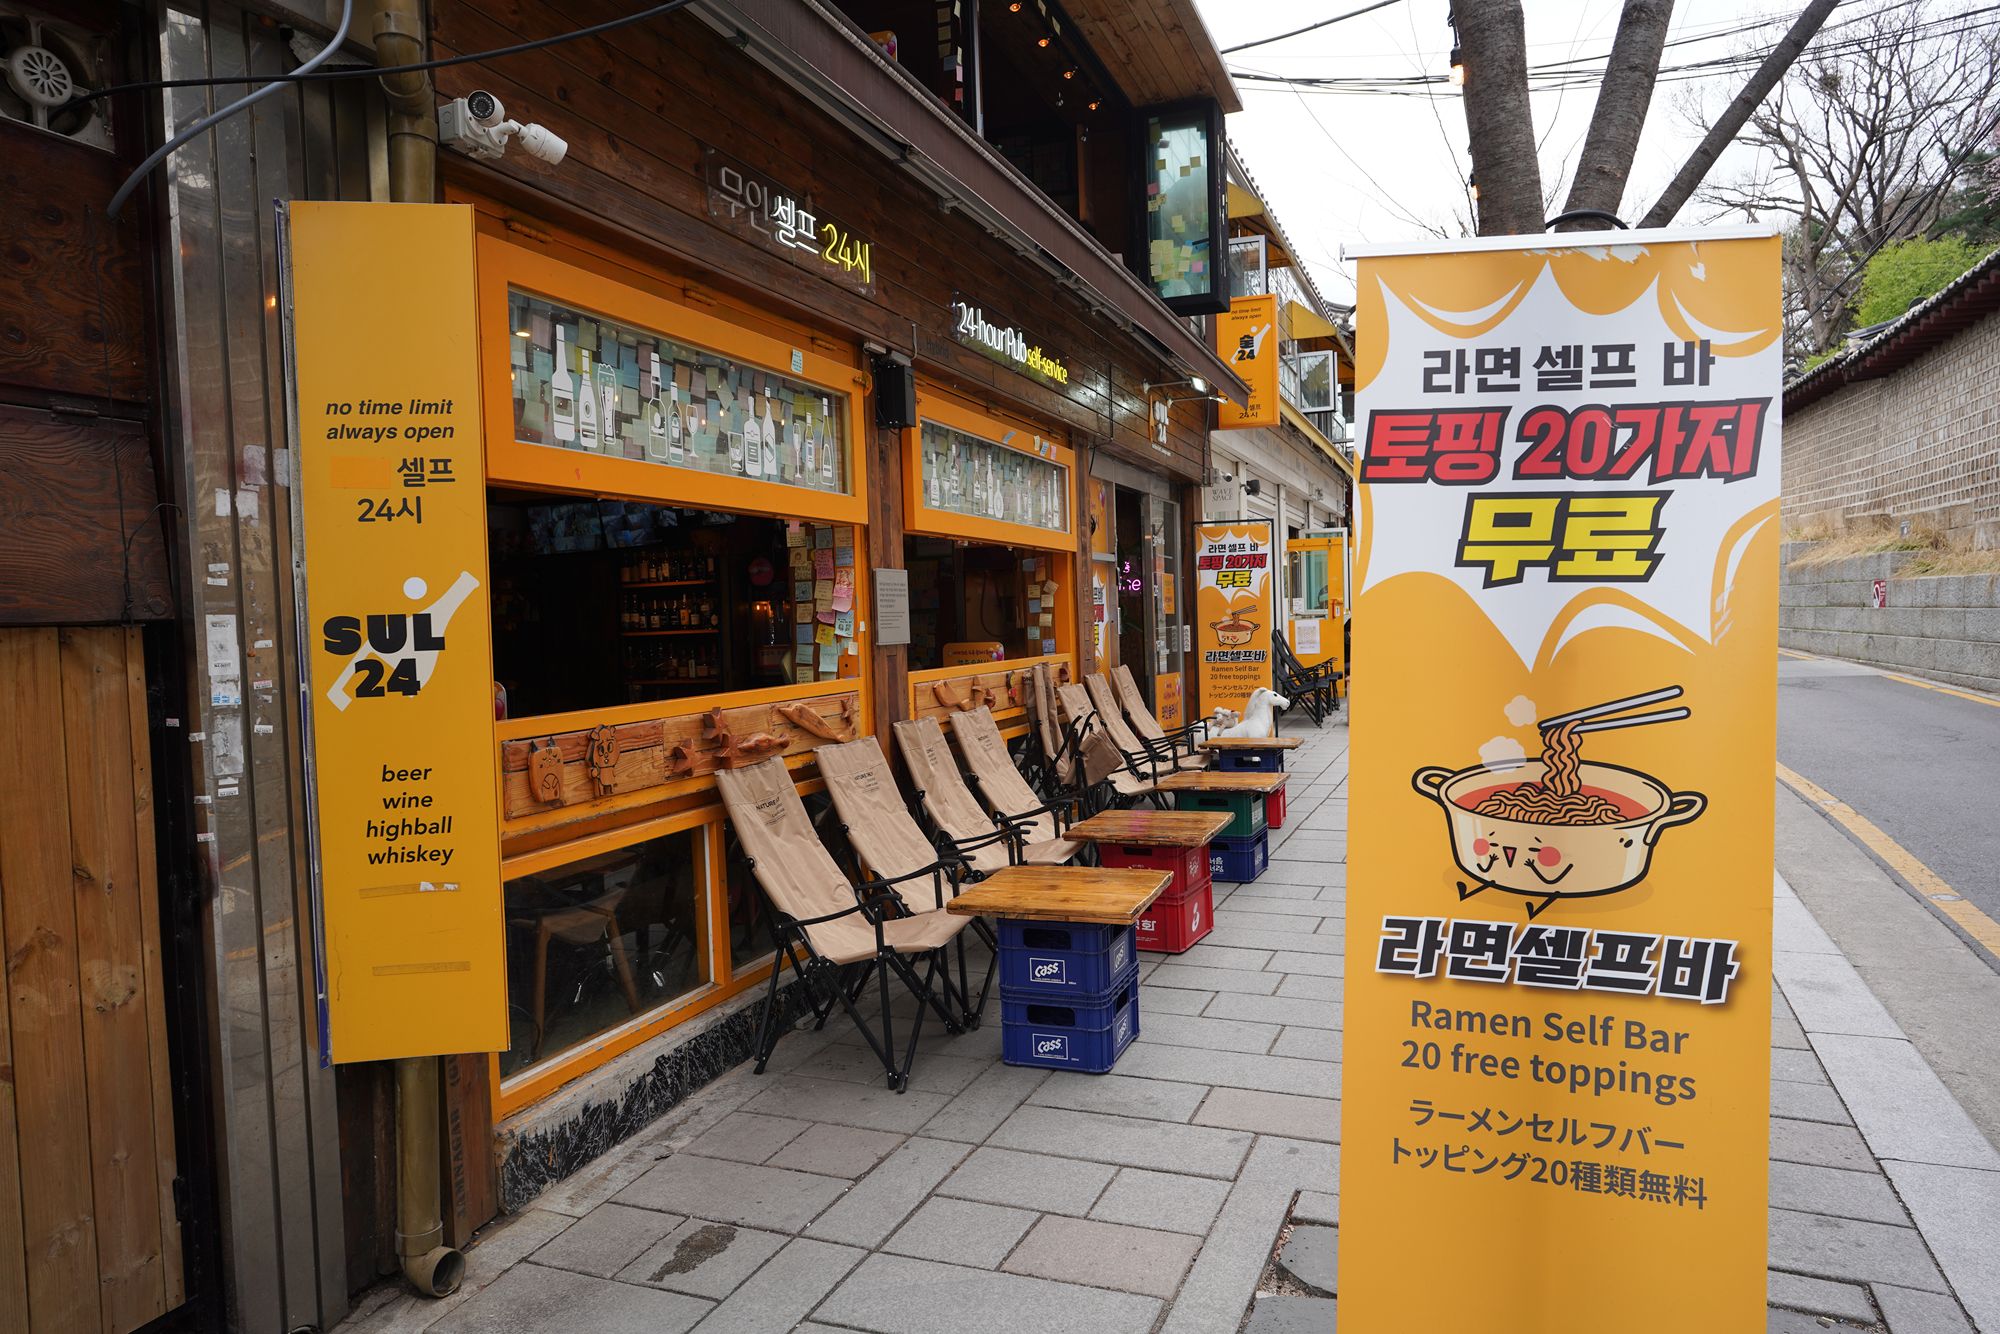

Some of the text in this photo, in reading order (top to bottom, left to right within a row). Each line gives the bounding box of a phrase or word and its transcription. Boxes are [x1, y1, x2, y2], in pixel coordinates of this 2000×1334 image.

[720, 166, 870, 284] 무인 셀프 24시
[1006, 326, 1027, 363] Pub
[1027, 346, 1068, 385] self-service
[1238, 349, 1255, 361] 24
[1423, 339, 1716, 394] 라면 셀프 바
[326, 399, 453, 415] no time limit
[327, 424, 455, 443] always open
[1359, 396, 1773, 486] 토핑 20가지
[397, 457, 455, 487] 셀프
[1212, 488, 1233, 496] WAVE
[357, 496, 422, 524] 24시
[1209, 542, 1259, 554] 라면 셀프 바
[1454, 490, 1674, 590] 무료
[1198, 553, 1267, 570] 토핑 20가지
[1216, 570, 1252, 589] 무료
[323, 613, 445, 656] SUL
[1204, 649, 1267, 663] 라면셀프바
[355, 658, 421, 698] 24
[1233, 673, 1261, 681] toppings
[382, 764, 432, 782] beer
[382, 792, 433, 809] wine
[366, 816, 452, 842] highball
[368, 844, 454, 866] whiskey
[1375, 915, 1741, 1005] 라면셀프바
[1410, 1000, 1690, 1055] Ramen Self Bar
[1401, 1040, 1697, 1106] 20 free toppings
[1409, 1099, 1685, 1155] ラーメンセルフバー
[1393, 1137, 1708, 1210] トッピング20種類無料
